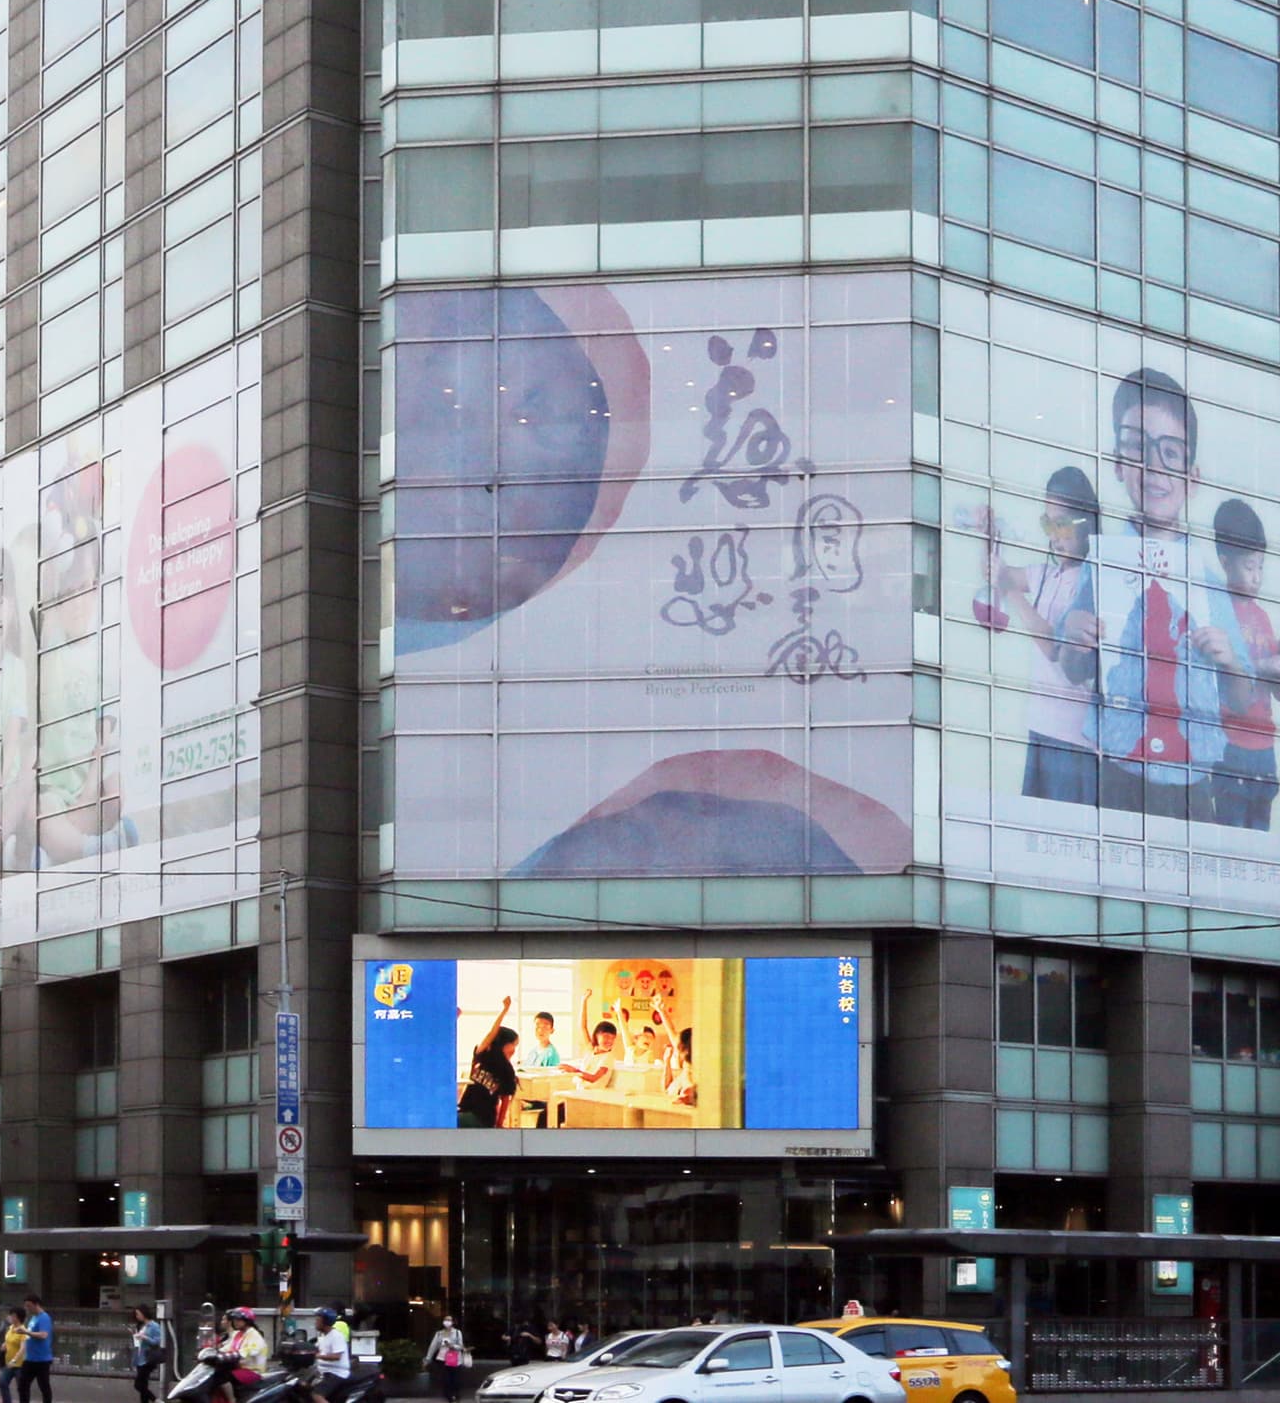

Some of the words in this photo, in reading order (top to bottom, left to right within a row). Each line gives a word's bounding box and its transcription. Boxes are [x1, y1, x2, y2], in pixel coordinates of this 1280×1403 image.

[644, 682, 688, 697] Brings
[691, 679, 756, 695] Perfection
[838, 957, 856, 1025] 洽各校。
[373, 1008, 415, 1021] 何嘉仁
